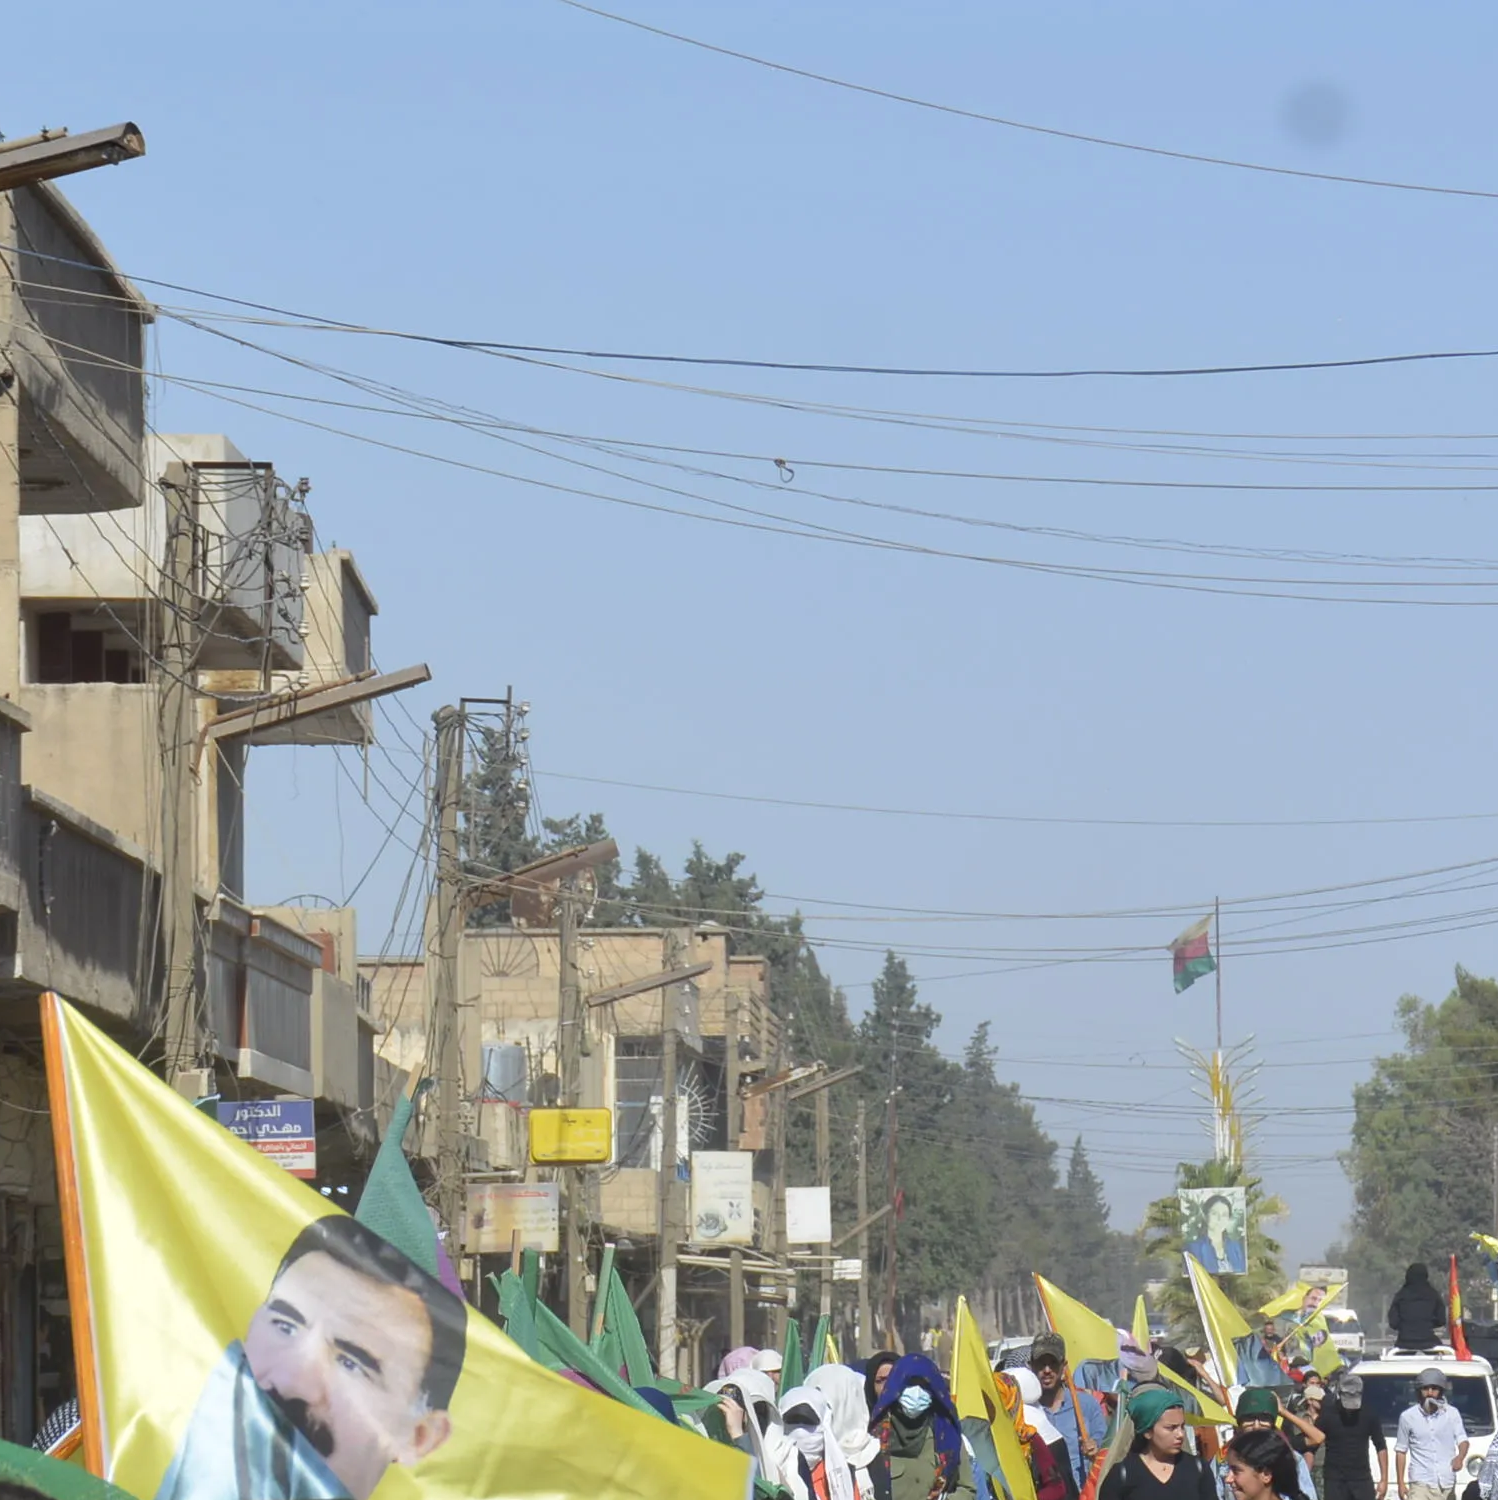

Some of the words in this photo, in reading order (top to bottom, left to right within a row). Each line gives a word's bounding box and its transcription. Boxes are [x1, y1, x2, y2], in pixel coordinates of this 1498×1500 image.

[235, 1104, 281, 1121] الدكتور
[229, 1122, 252, 1135] أحم
[256, 1123, 302, 1137] مهدي
